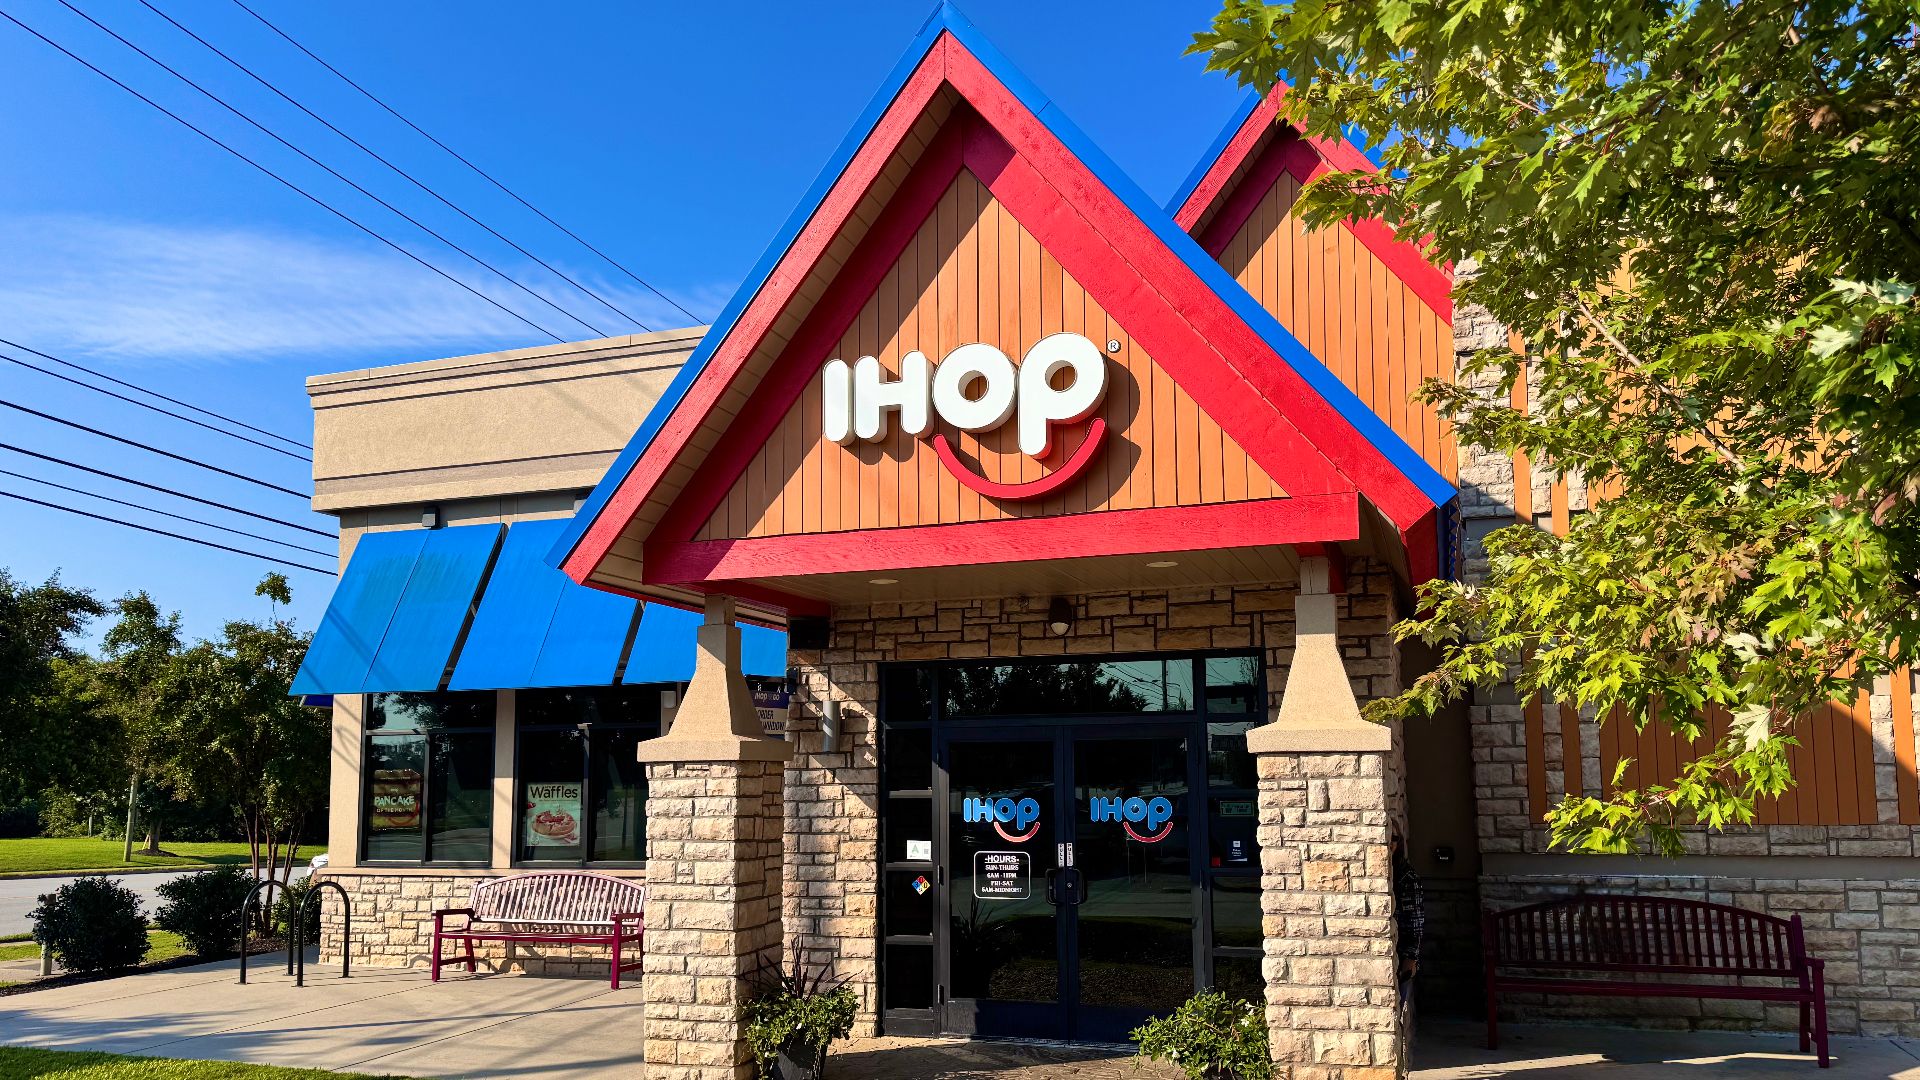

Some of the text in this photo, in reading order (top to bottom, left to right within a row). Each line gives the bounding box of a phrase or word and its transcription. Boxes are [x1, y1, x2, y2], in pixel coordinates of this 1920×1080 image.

[822, 331, 1109, 460] IHOP
[374, 795, 415, 807] PANCAKE
[530, 785, 578, 799] Waffles
[963, 797, 1040, 831] IHOP
[1090, 796, 1173, 831] IHOP
